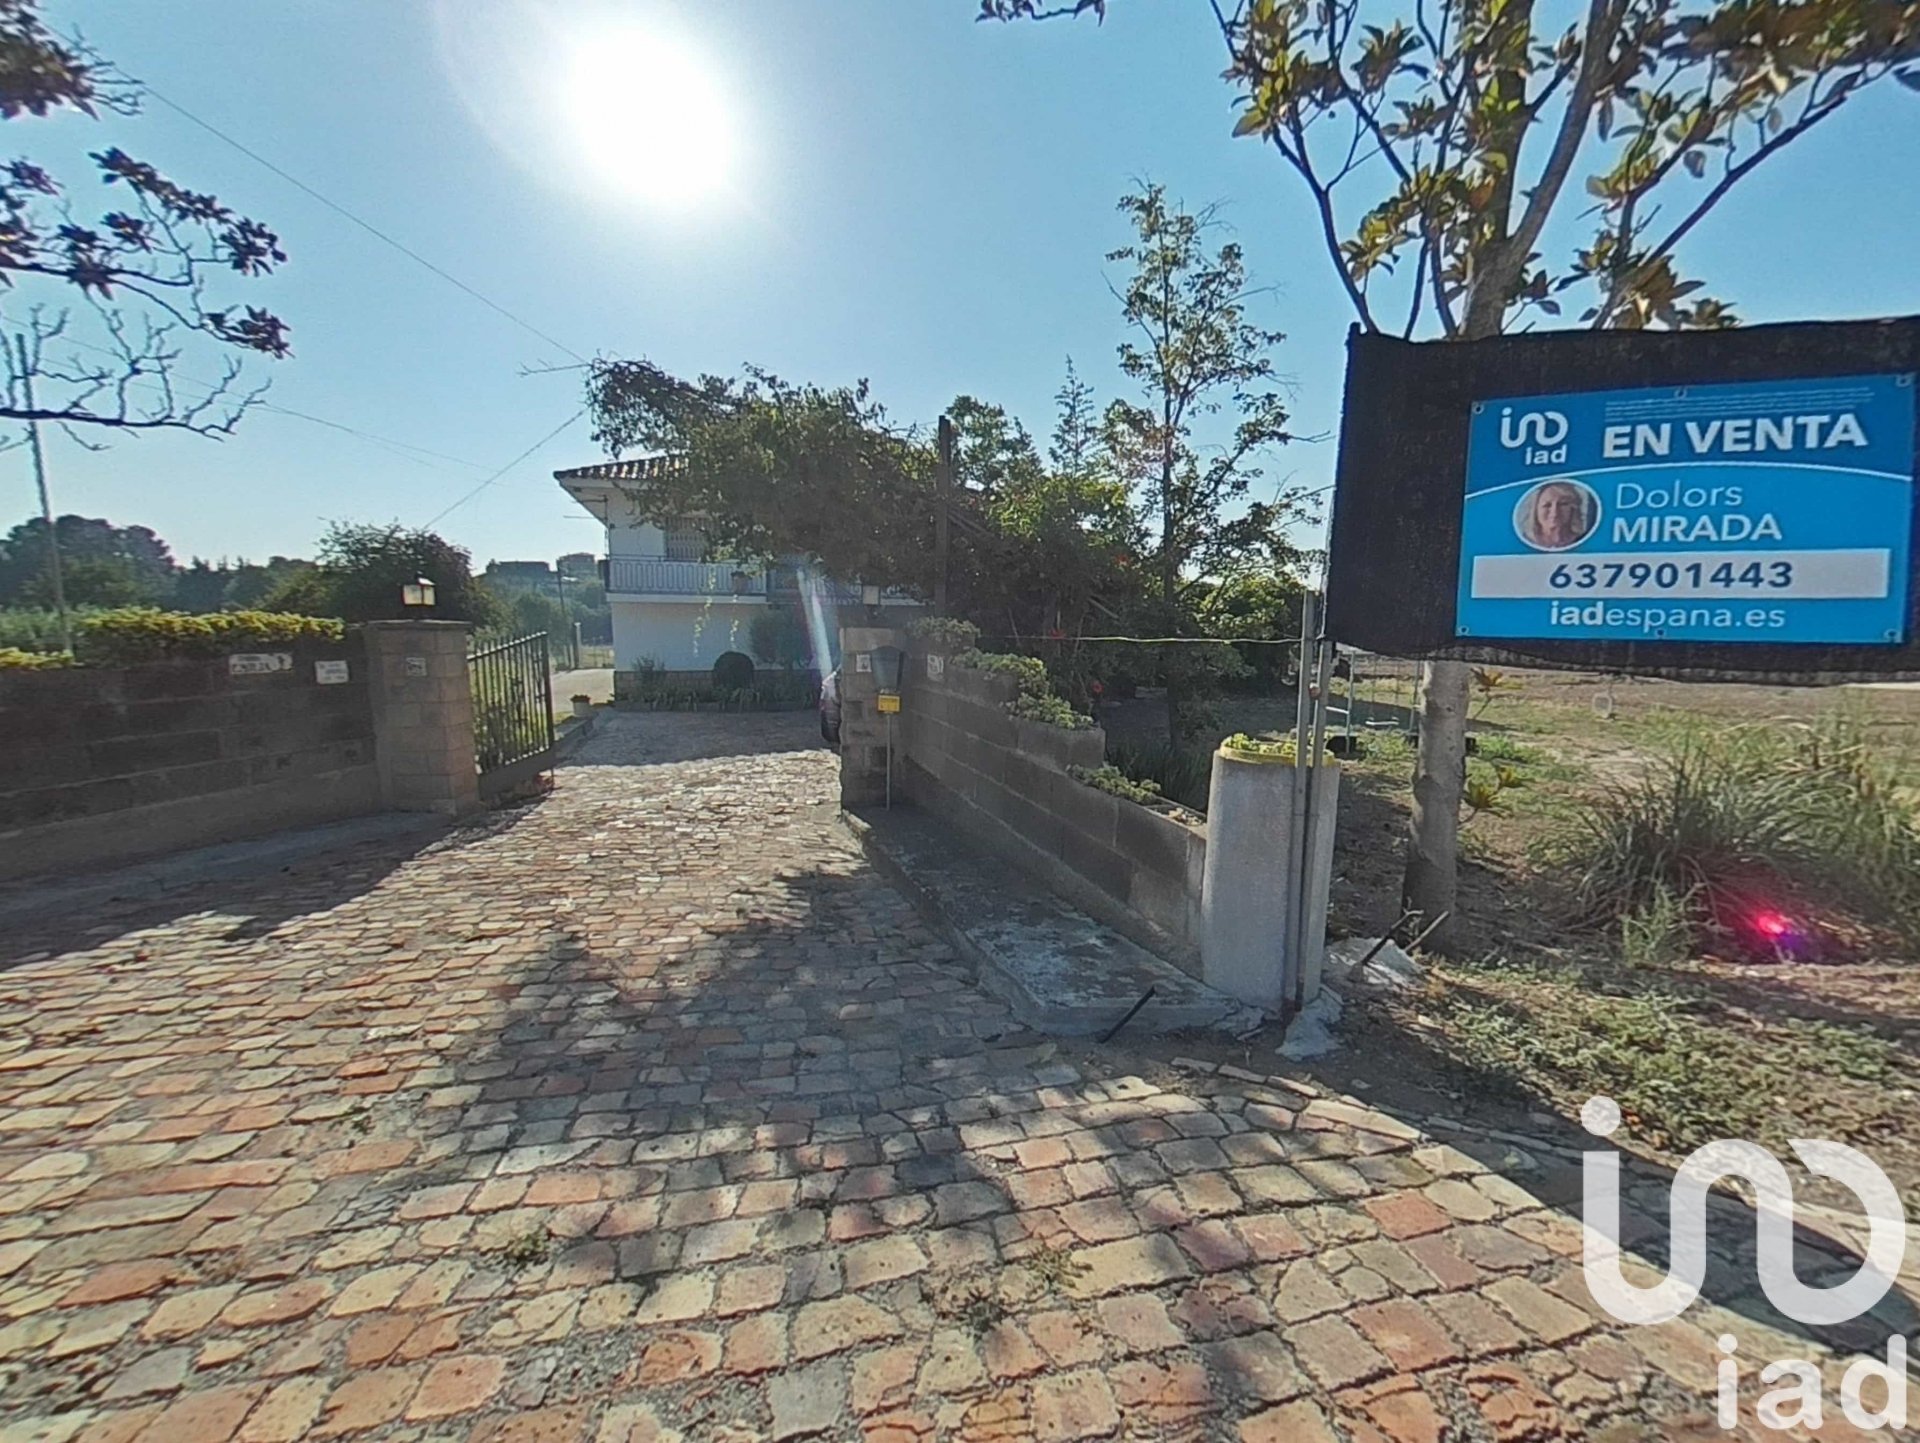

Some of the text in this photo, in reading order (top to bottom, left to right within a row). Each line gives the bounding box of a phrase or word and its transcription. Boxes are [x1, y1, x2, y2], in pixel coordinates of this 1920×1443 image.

[1603, 413, 1868, 458] EN VENTA
[1525, 445, 1567, 465] iad
[1615, 481, 1743, 510] Dolors
[1611, 513, 1783, 543] MIRADA
[1549, 561, 1794, 589] 637901443
[1550, 601, 1785, 632] iadespana.es
